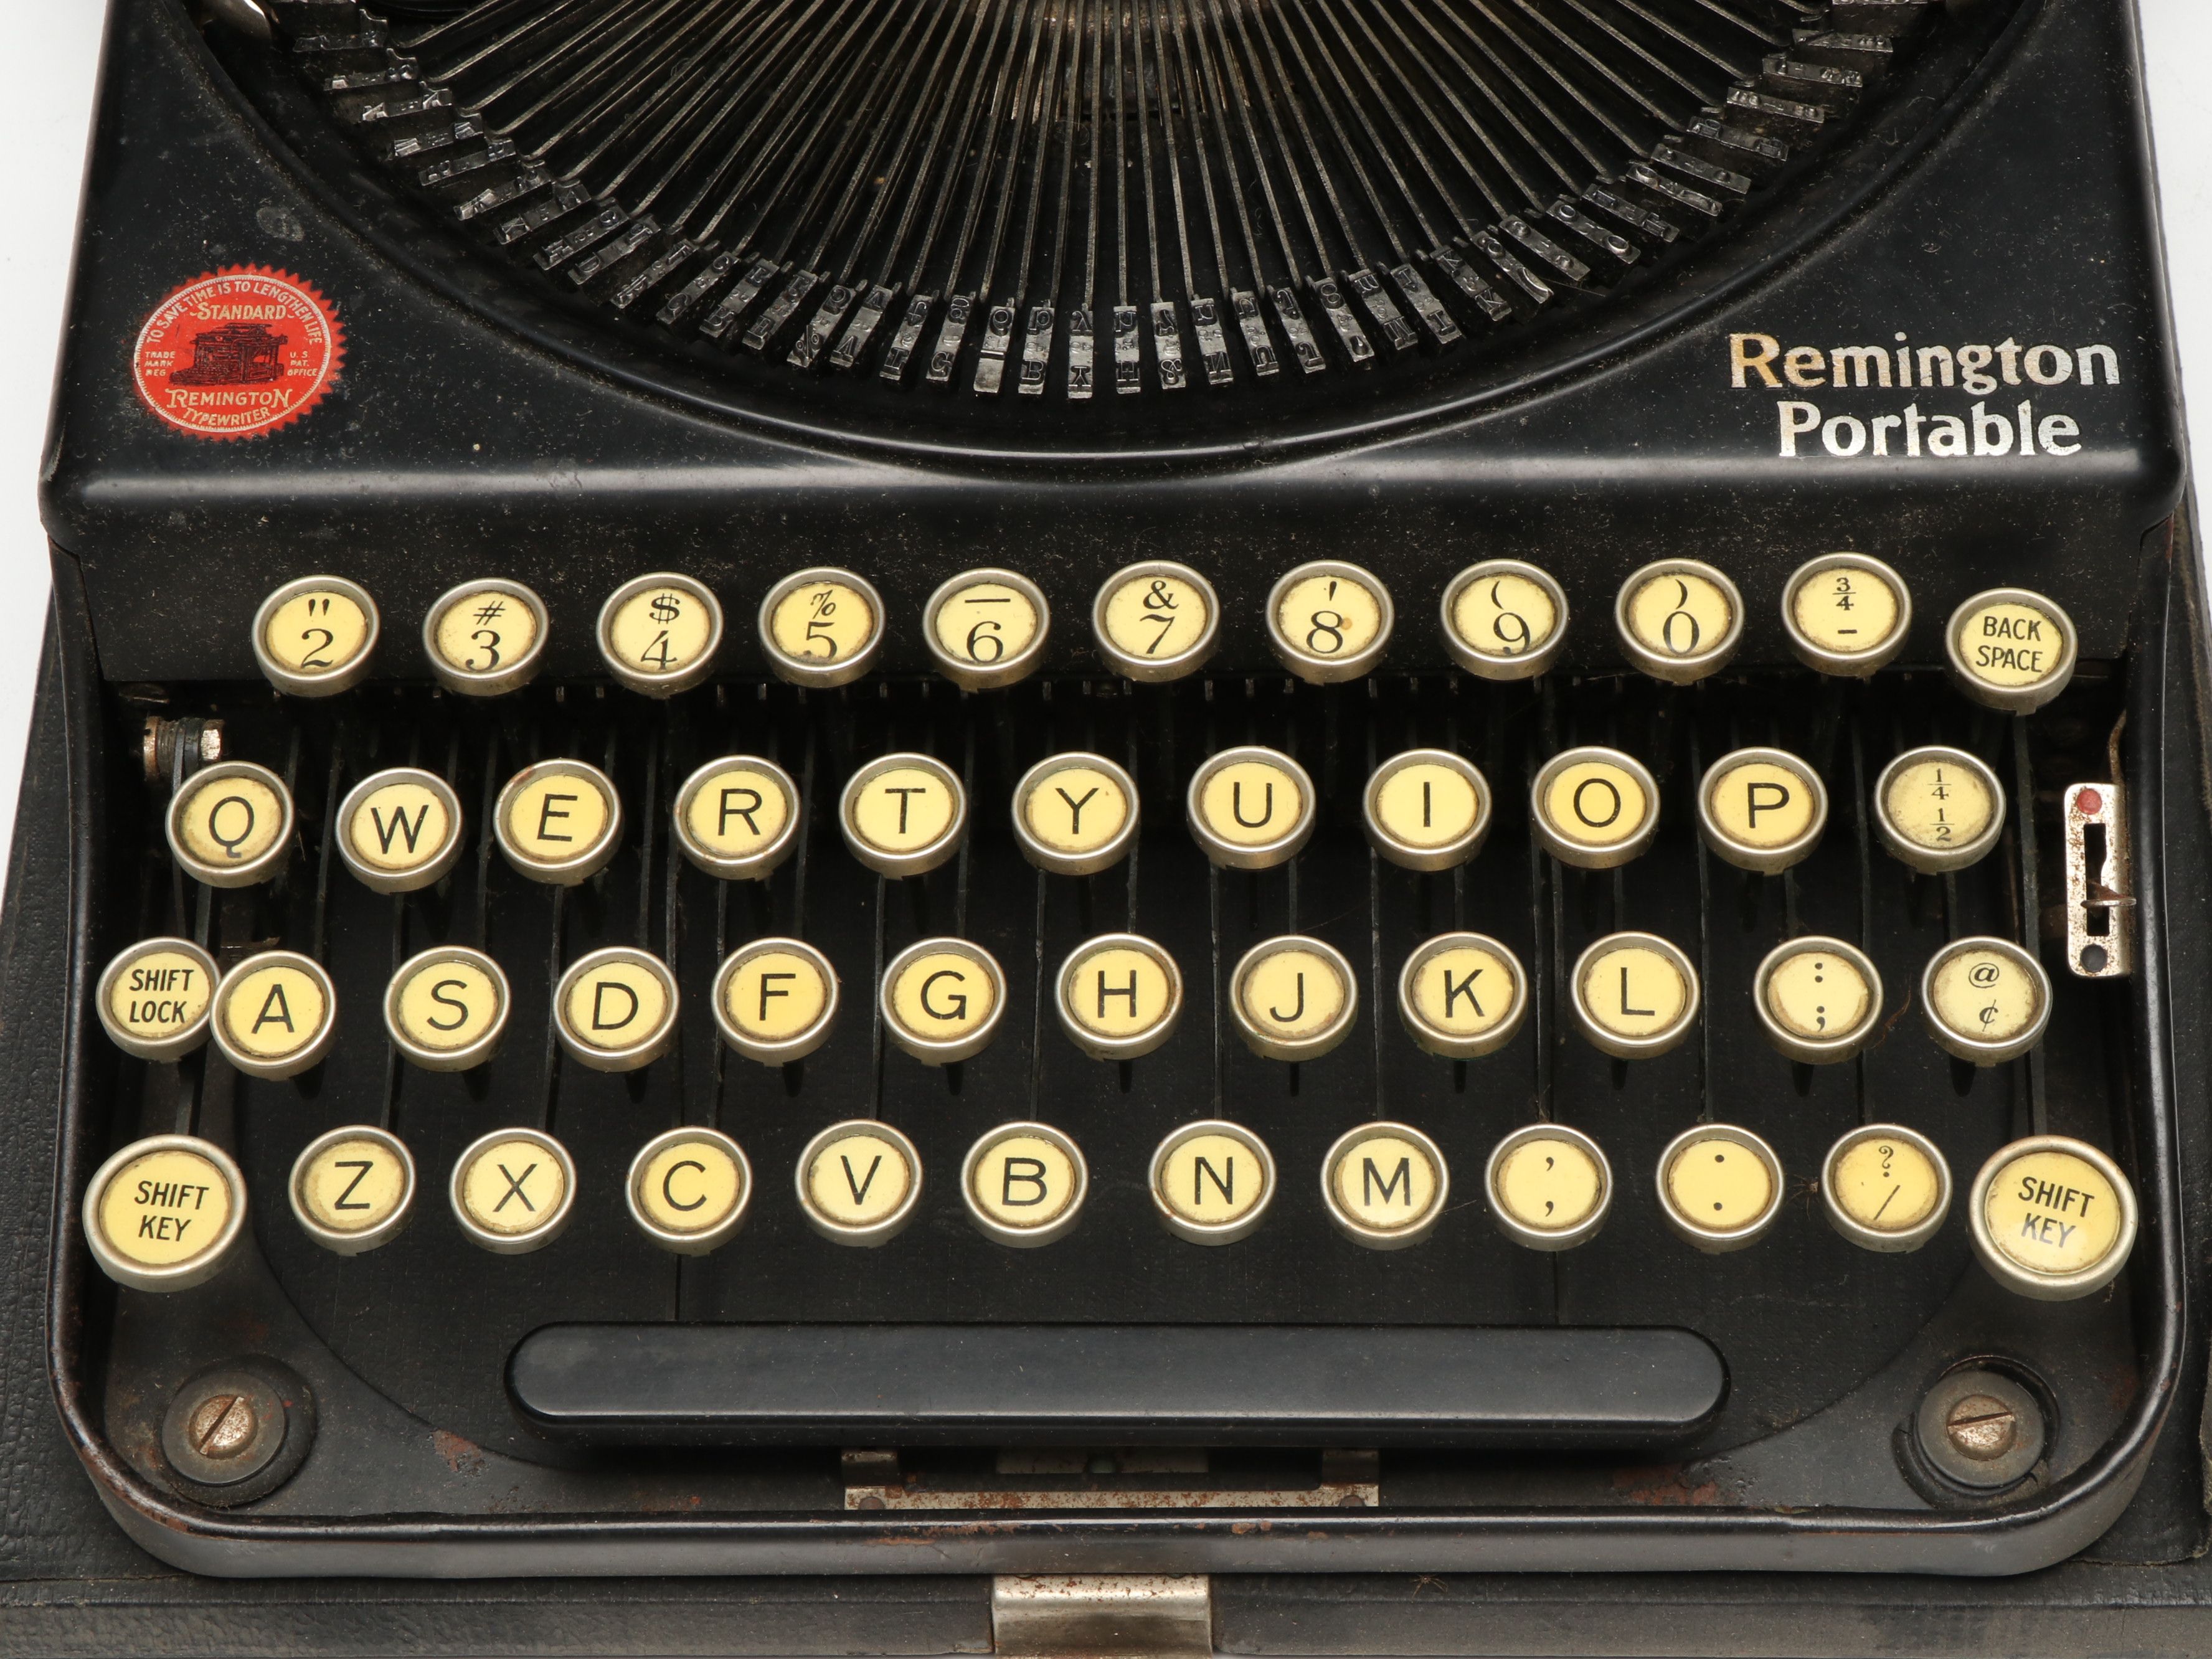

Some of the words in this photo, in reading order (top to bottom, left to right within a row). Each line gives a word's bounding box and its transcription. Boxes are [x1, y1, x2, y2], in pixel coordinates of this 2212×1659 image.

[147, 329, 164, 343] TO
[156, 303, 188, 329] SAVE
[183, 287, 216, 306] TIME
[217, 282, 231, 295] IS
[235, 281, 250, 292] TO
[253, 282, 314, 323] LENGTHEN
[305, 321, 323, 345] LIFE
[197, 302, 286, 320] STANDARD
[287, 368, 318, 376] OFFICE
[1729, 333, 2120, 396] Remington
[165, 388, 293, 408] REMINGTON
[182, 407, 270, 426] TYPEWRITER
[1777, 400, 2082, 457] Portable
[474, 602, 505, 625] #
[650, 593, 680, 623] $
[811, 590, 836, 618] %
[1142, 579, 1179, 609] &
[1491, 581, 1502, 608] (
[1676, 580, 1688, 608] )
[300, 629, 333, 669] 2
[804, 622, 838, 660] 5
[965, 621, 1004, 663] 6
[1140, 614, 1175, 654] 7
[1305, 610, 1344, 654] 8
[1492, 612, 1531, 655] 9
[1662, 611, 1700, 654] 0
[1982, 615, 2042, 640] BACK
[465, 630, 501, 671] 3
[640, 630, 678, 671] 4
[1975, 645, 2043, 674] SPACE
[537, 794, 577, 841] E
[719, 788, 762, 836] R
[885, 788, 925, 833] T
[1056, 788, 1099, 834] Y
[1234, 782, 1272, 828] U
[1424, 782, 1430, 827] I
[1574, 778, 1620, 828] O
[1748, 783, 1789, 828] P
[208, 795, 255, 859] Q
[371, 805, 428, 854] W
[130, 969, 194, 991] SHIFT
[1098, 970, 1136, 1018] H
[1444, 970, 1484, 1018] K
[1621, 967, 1655, 1016] L
[1815, 963, 1823, 983] :
[1969, 963, 1999, 988] @
[130, 1001, 186, 1023] LOCK
[252, 984, 294, 1034] A
[427, 980, 468, 1031] S
[592, 982, 638, 1030] D
[760, 973, 795, 1021] F
[921, 971, 966, 1019] G
[1270, 973, 1303, 1022] J
[1978, 1000, 1999, 1031] ¢
[1817, 1006, 1825, 1033] ;
[841, 1156, 881, 1205] V
[1003, 1158, 1047, 1206] B
[1195, 1157, 1232, 1204] N
[1363, 1158, 1410, 1206] M
[1879, 1146, 1893, 1177] ?
[135, 1181, 209, 1209] SHIFT
[334, 1161, 373, 1210] Z
[493, 1164, 537, 1212] X
[663, 1161, 706, 1211] C
[2017, 1176, 2096, 1217] SHIFT
[139, 1215, 191, 1241] KEY
[2021, 1212, 2076, 1248] KEY
